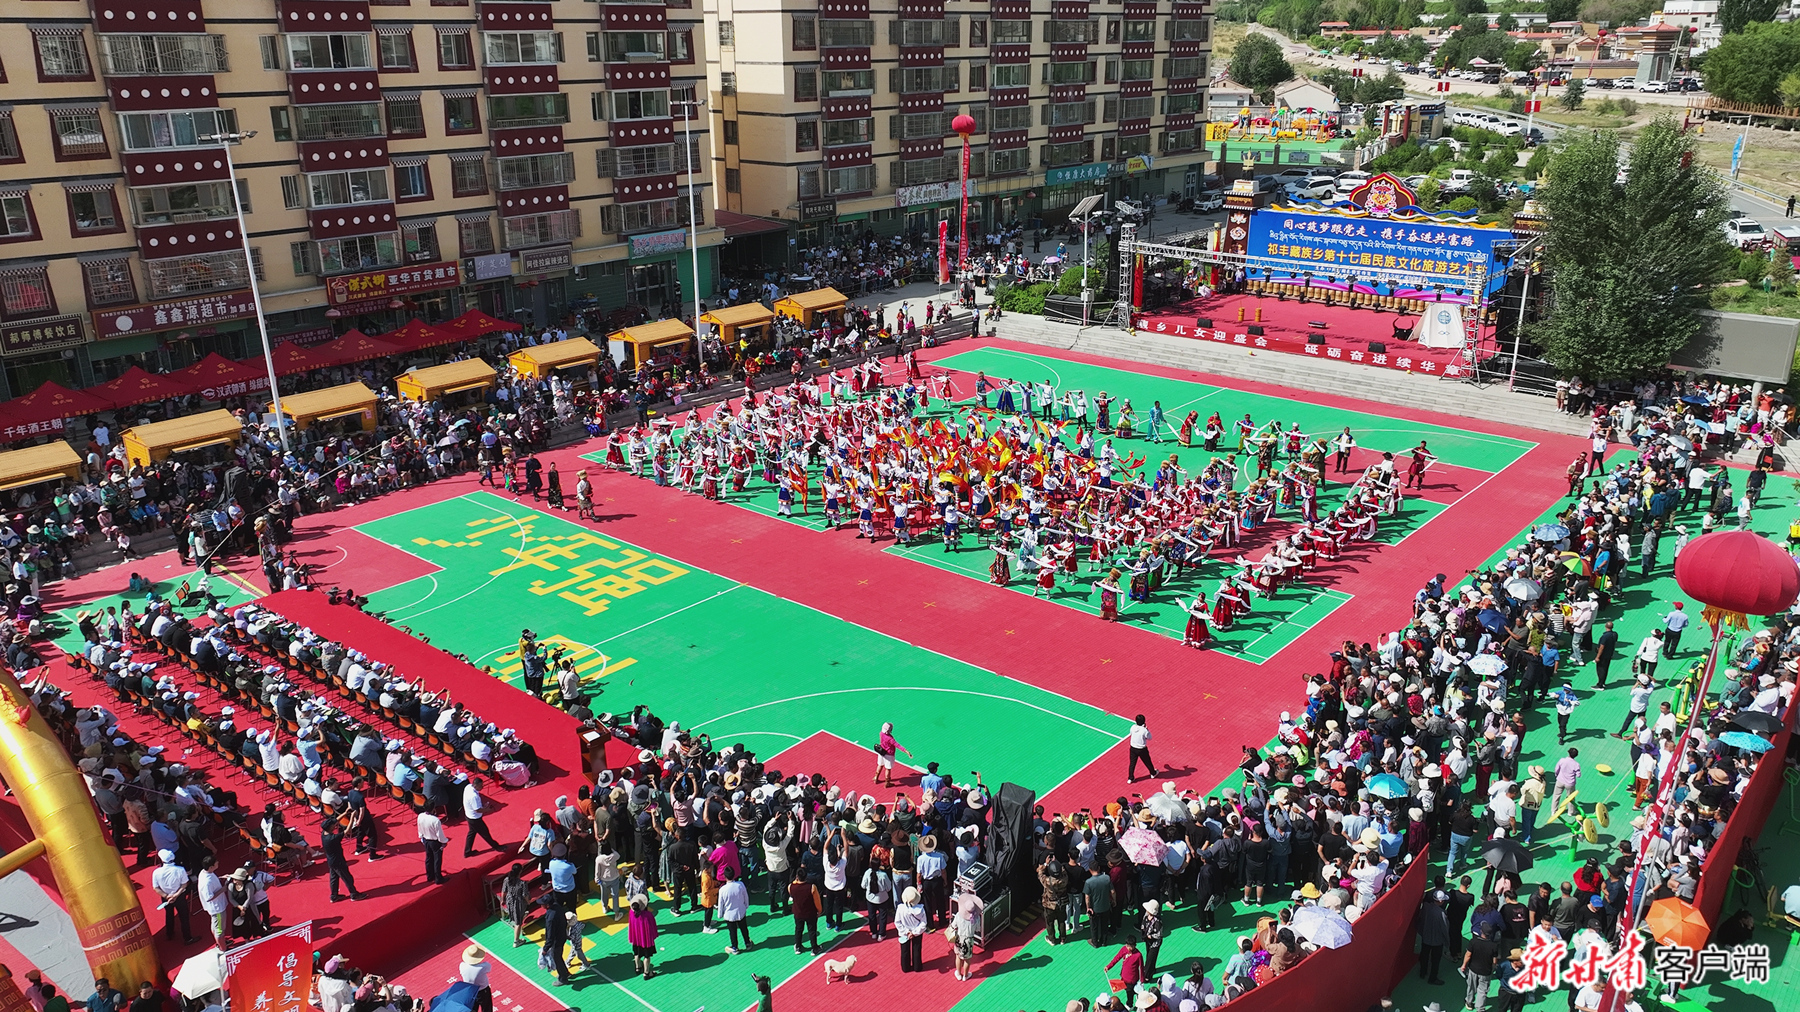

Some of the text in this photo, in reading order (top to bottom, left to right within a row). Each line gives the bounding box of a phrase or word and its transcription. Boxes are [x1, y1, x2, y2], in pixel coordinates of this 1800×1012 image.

[1283, 218, 1475, 247] 同心筑梦跟党走·携手奋进共富路
[388, 265, 456, 286] 亚华百货超市
[154, 301, 227, 325] 鑫鑫源超市
[229, 302, 255, 314] 加盟店
[1304, 343, 1463, 376] 砥砺奋进续华章
[216, 381, 247, 398] 汉武御酒
[3, 418, 63, 438] 千年酒王朝
